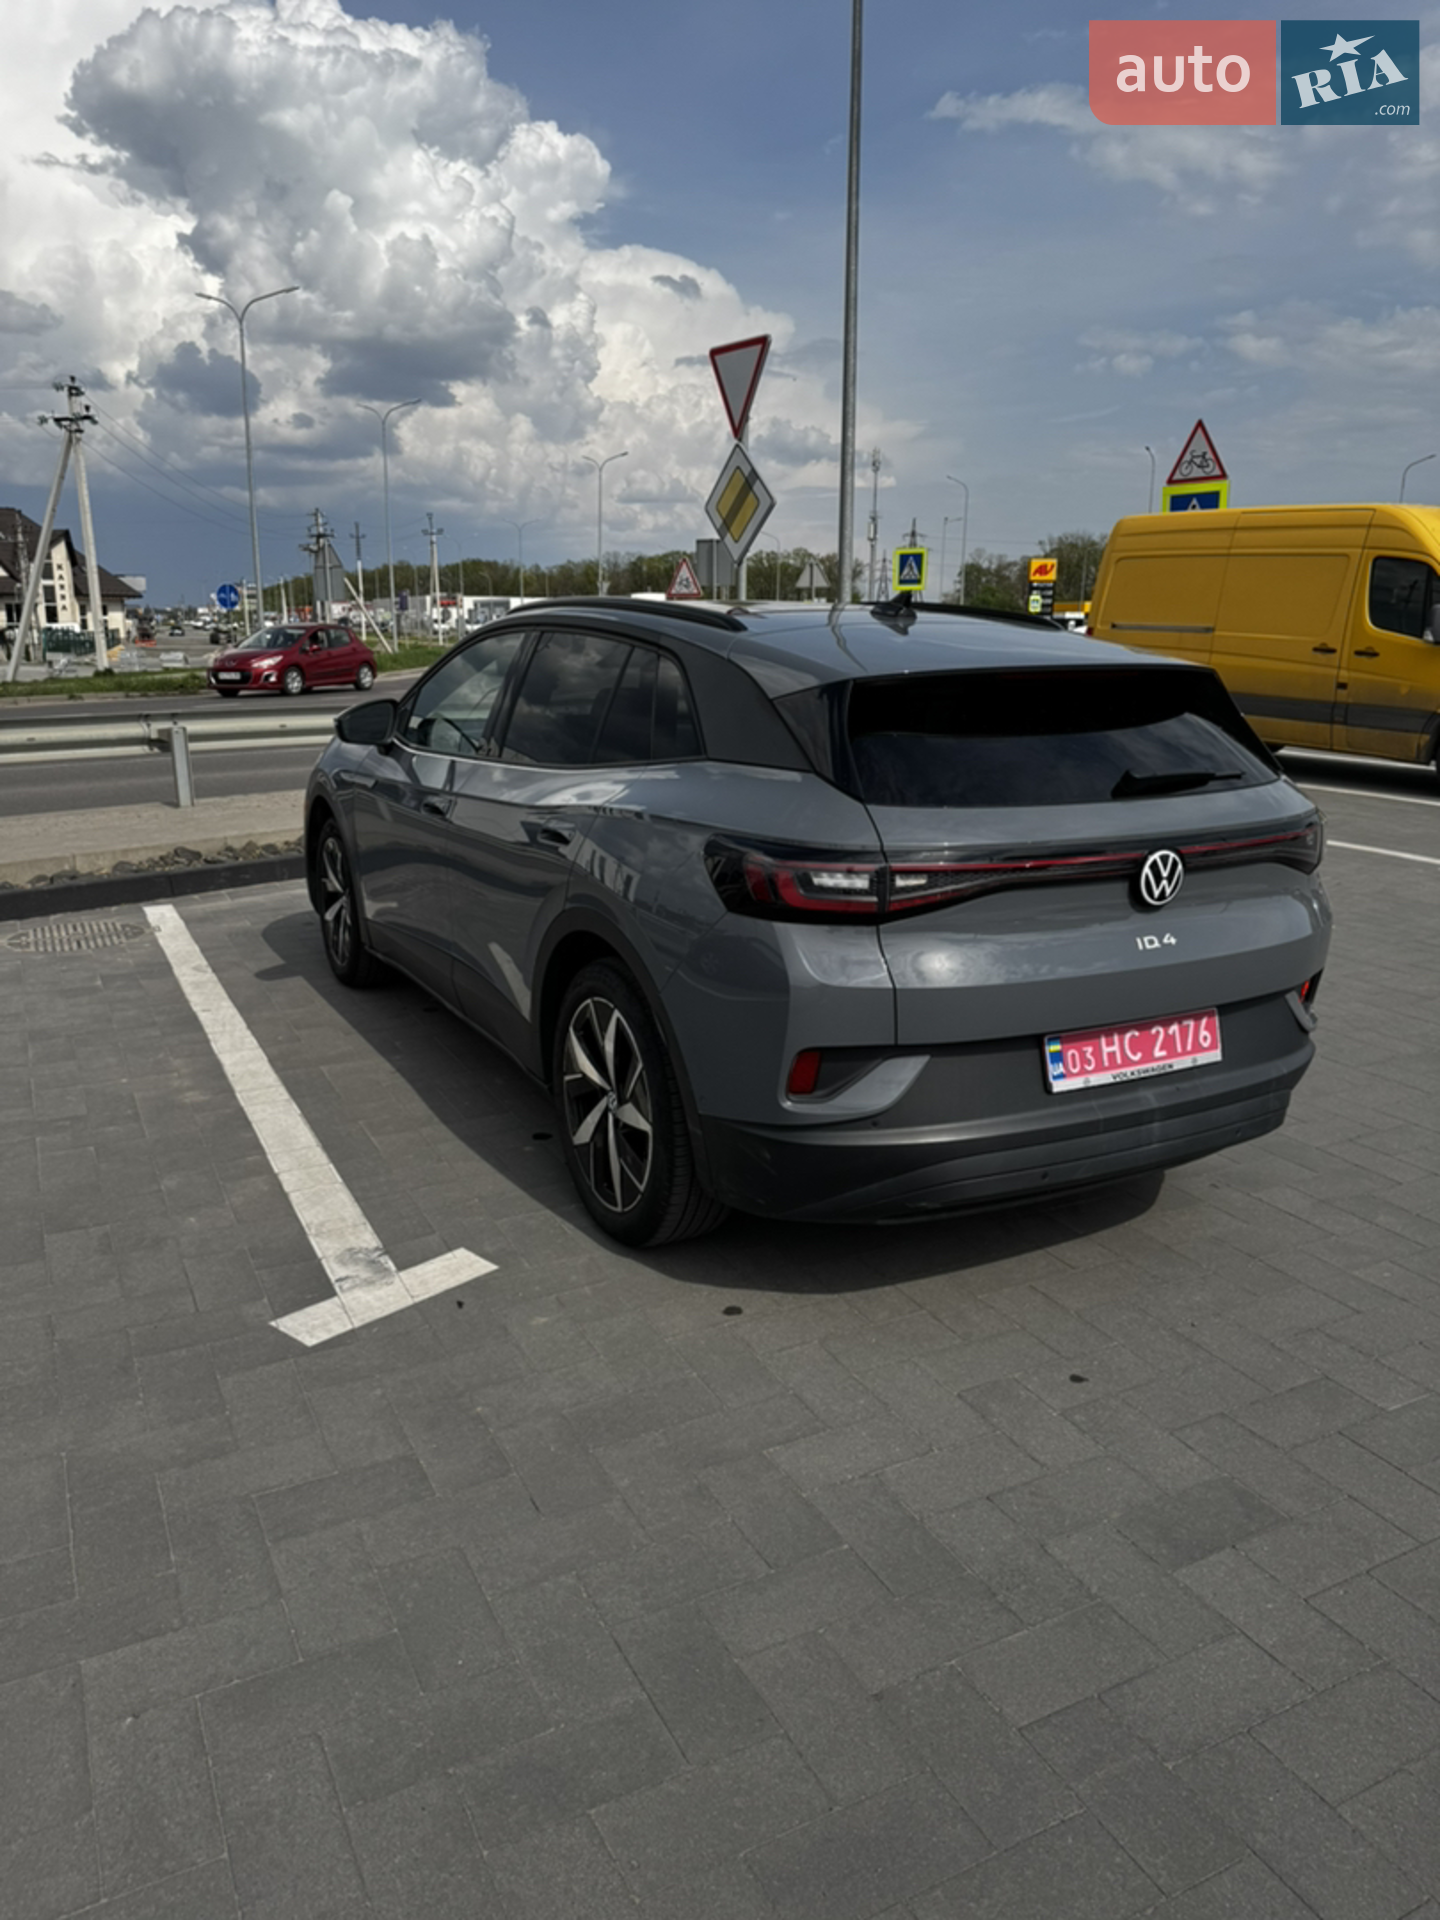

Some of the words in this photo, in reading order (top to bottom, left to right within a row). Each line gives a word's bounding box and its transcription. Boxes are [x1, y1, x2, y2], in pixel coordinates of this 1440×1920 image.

[1066, 1046, 1096, 1074] 03
[1100, 1030, 1143, 1067] HC
[1150, 1016, 1212, 1058] 2176
[1111, 1063, 1174, 1081] VOLKSWAGEN
